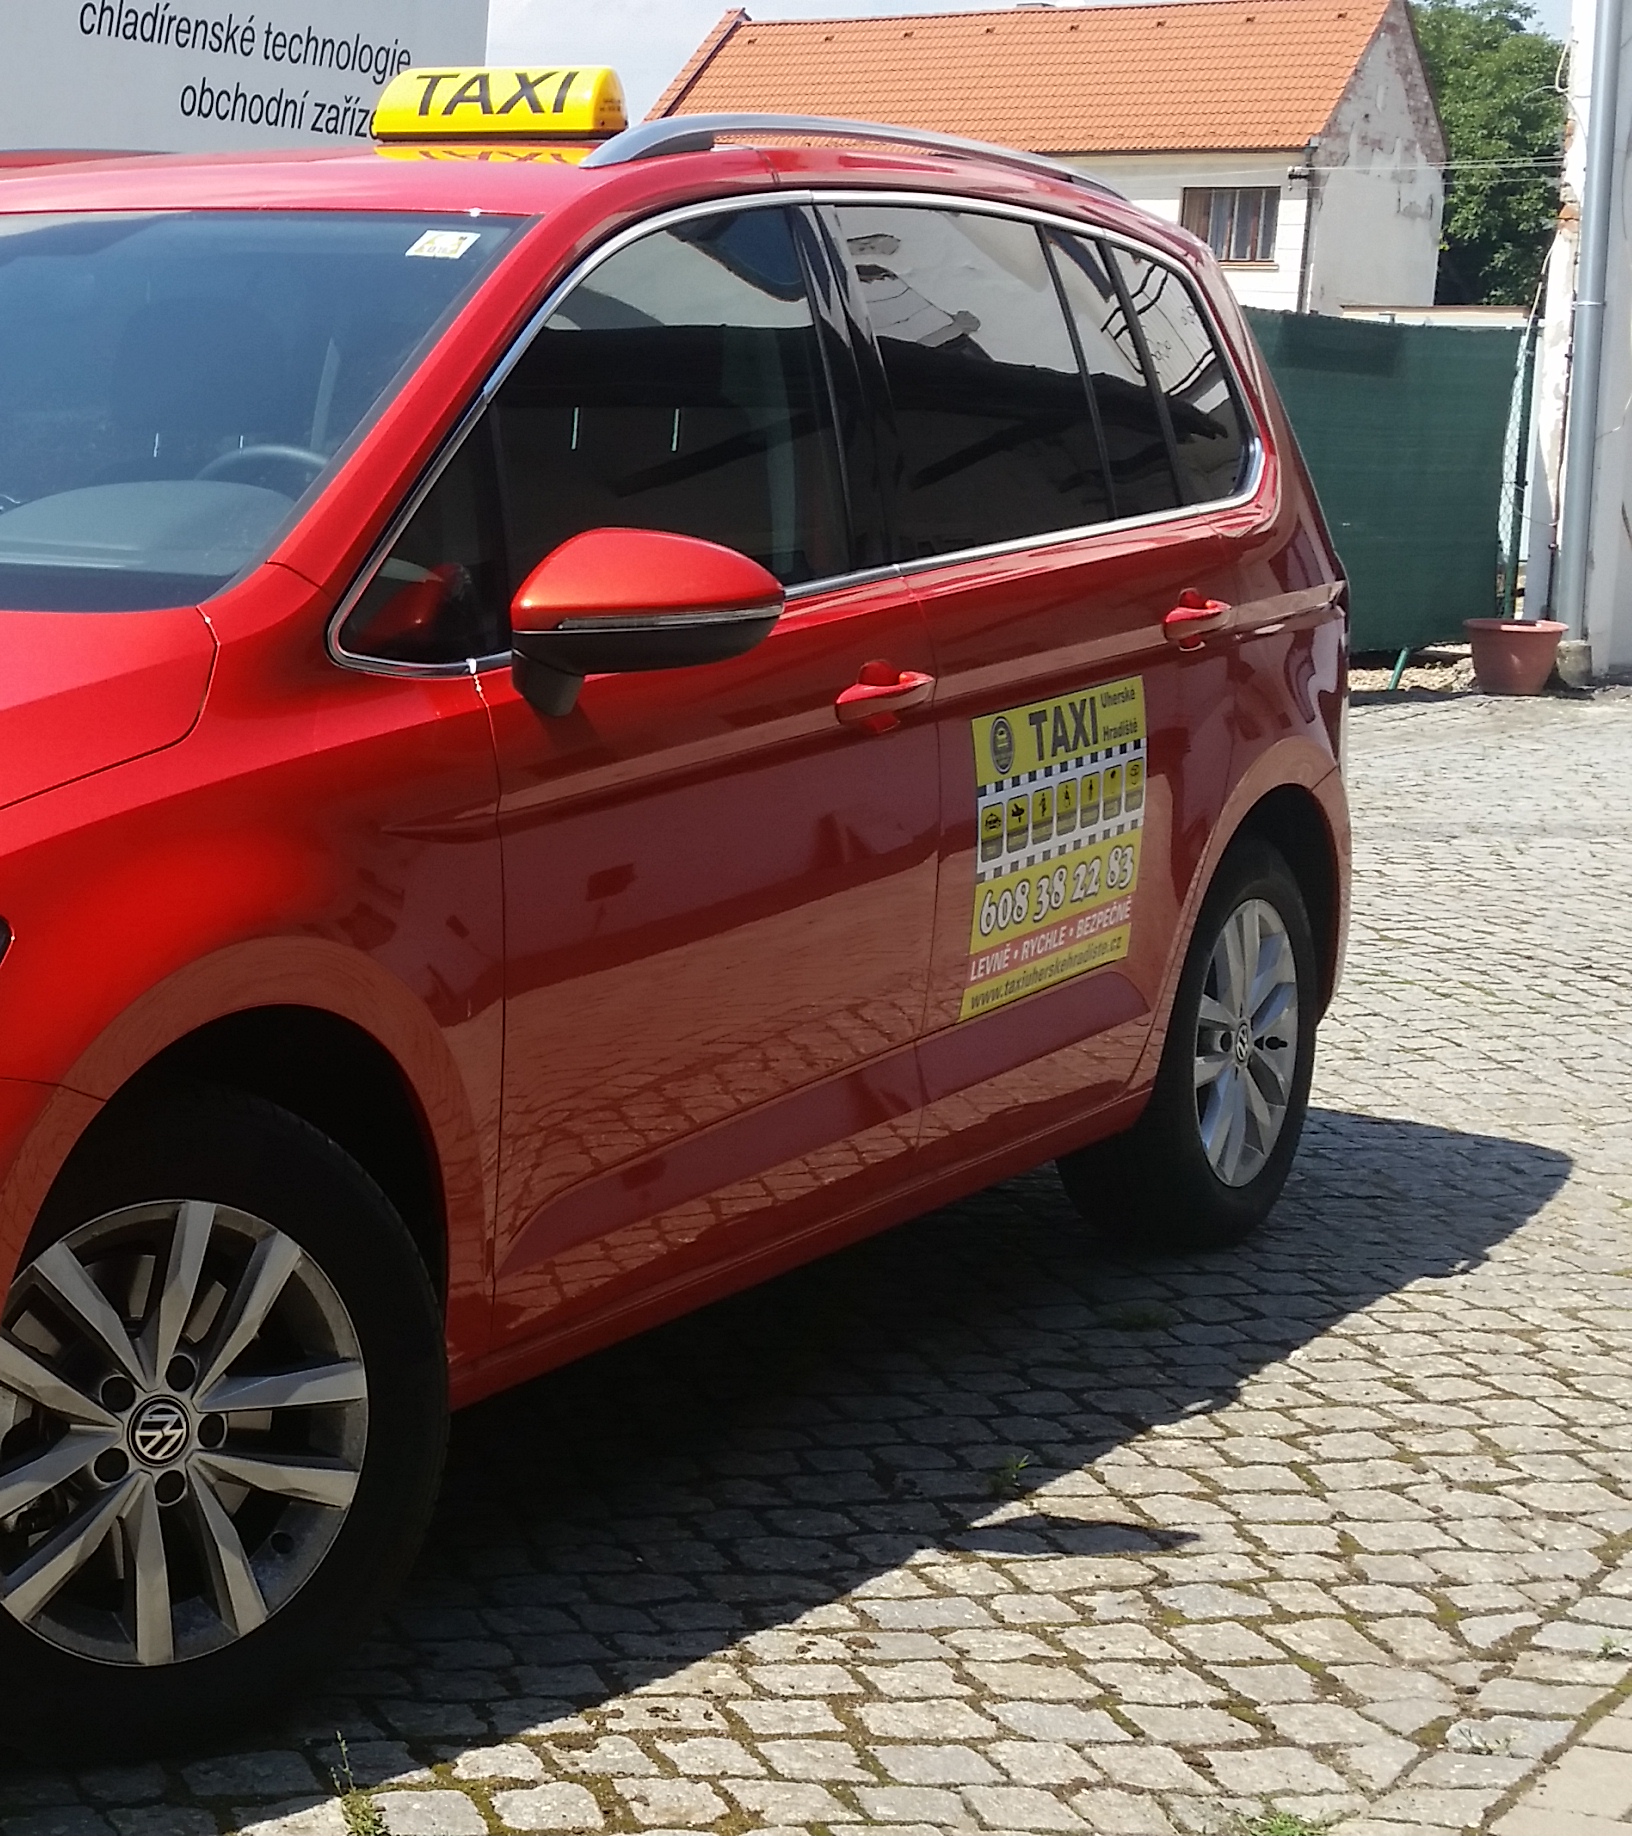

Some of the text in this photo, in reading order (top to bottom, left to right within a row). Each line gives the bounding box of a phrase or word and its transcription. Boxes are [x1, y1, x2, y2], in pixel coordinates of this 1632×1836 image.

[79, 0, 411, 85] chladírenské technologie
[180, 76, 309, 130] obchodní
[415, 70, 579, 117] TAXI
[1028, 695, 1100, 762] TAXI
[979, 844, 1135, 936] 608 38 22 83
[970, 895, 1132, 982] LEVNĚ RYCHLE BEZPEČNĚ
[970, 933, 1123, 1010] www.taxiuherskehradiste.cz
